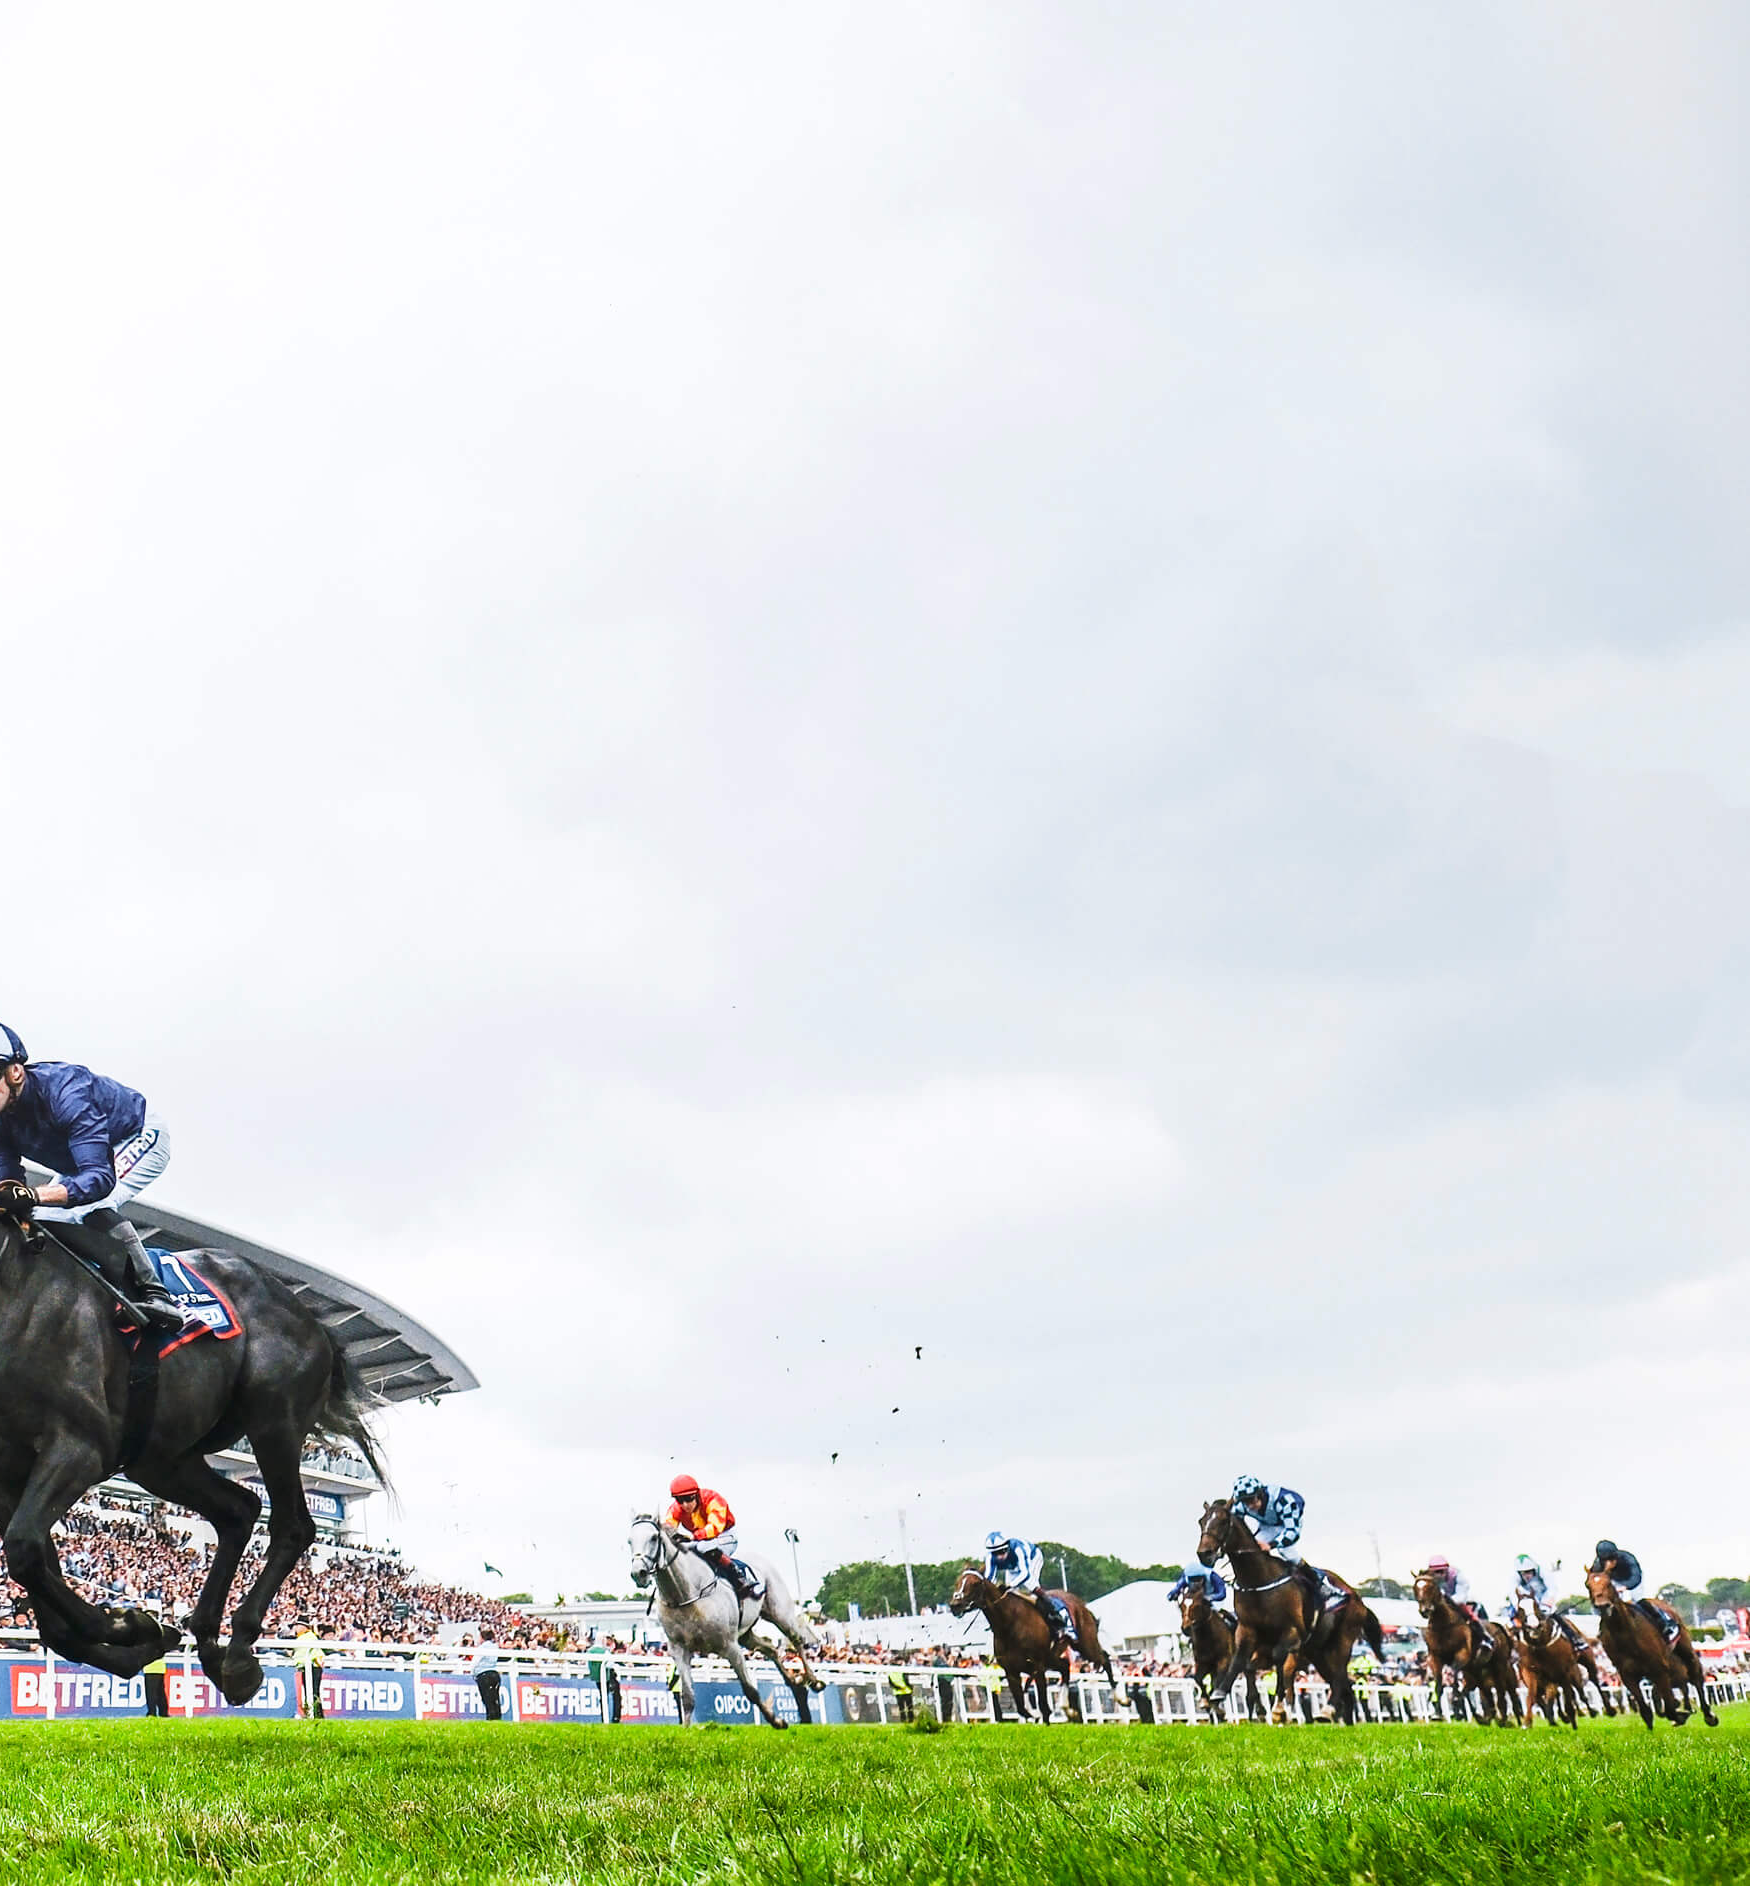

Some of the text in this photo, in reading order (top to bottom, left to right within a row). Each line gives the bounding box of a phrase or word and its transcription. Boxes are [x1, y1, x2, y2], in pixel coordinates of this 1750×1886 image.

[159, 1255, 195, 1293] 7
[168, 1675, 287, 1709] BETED
[301, 1679, 403, 1712] ETFRED
[421, 1683, 511, 1714] BETFRD
[621, 1689, 679, 1716] BETFRE
